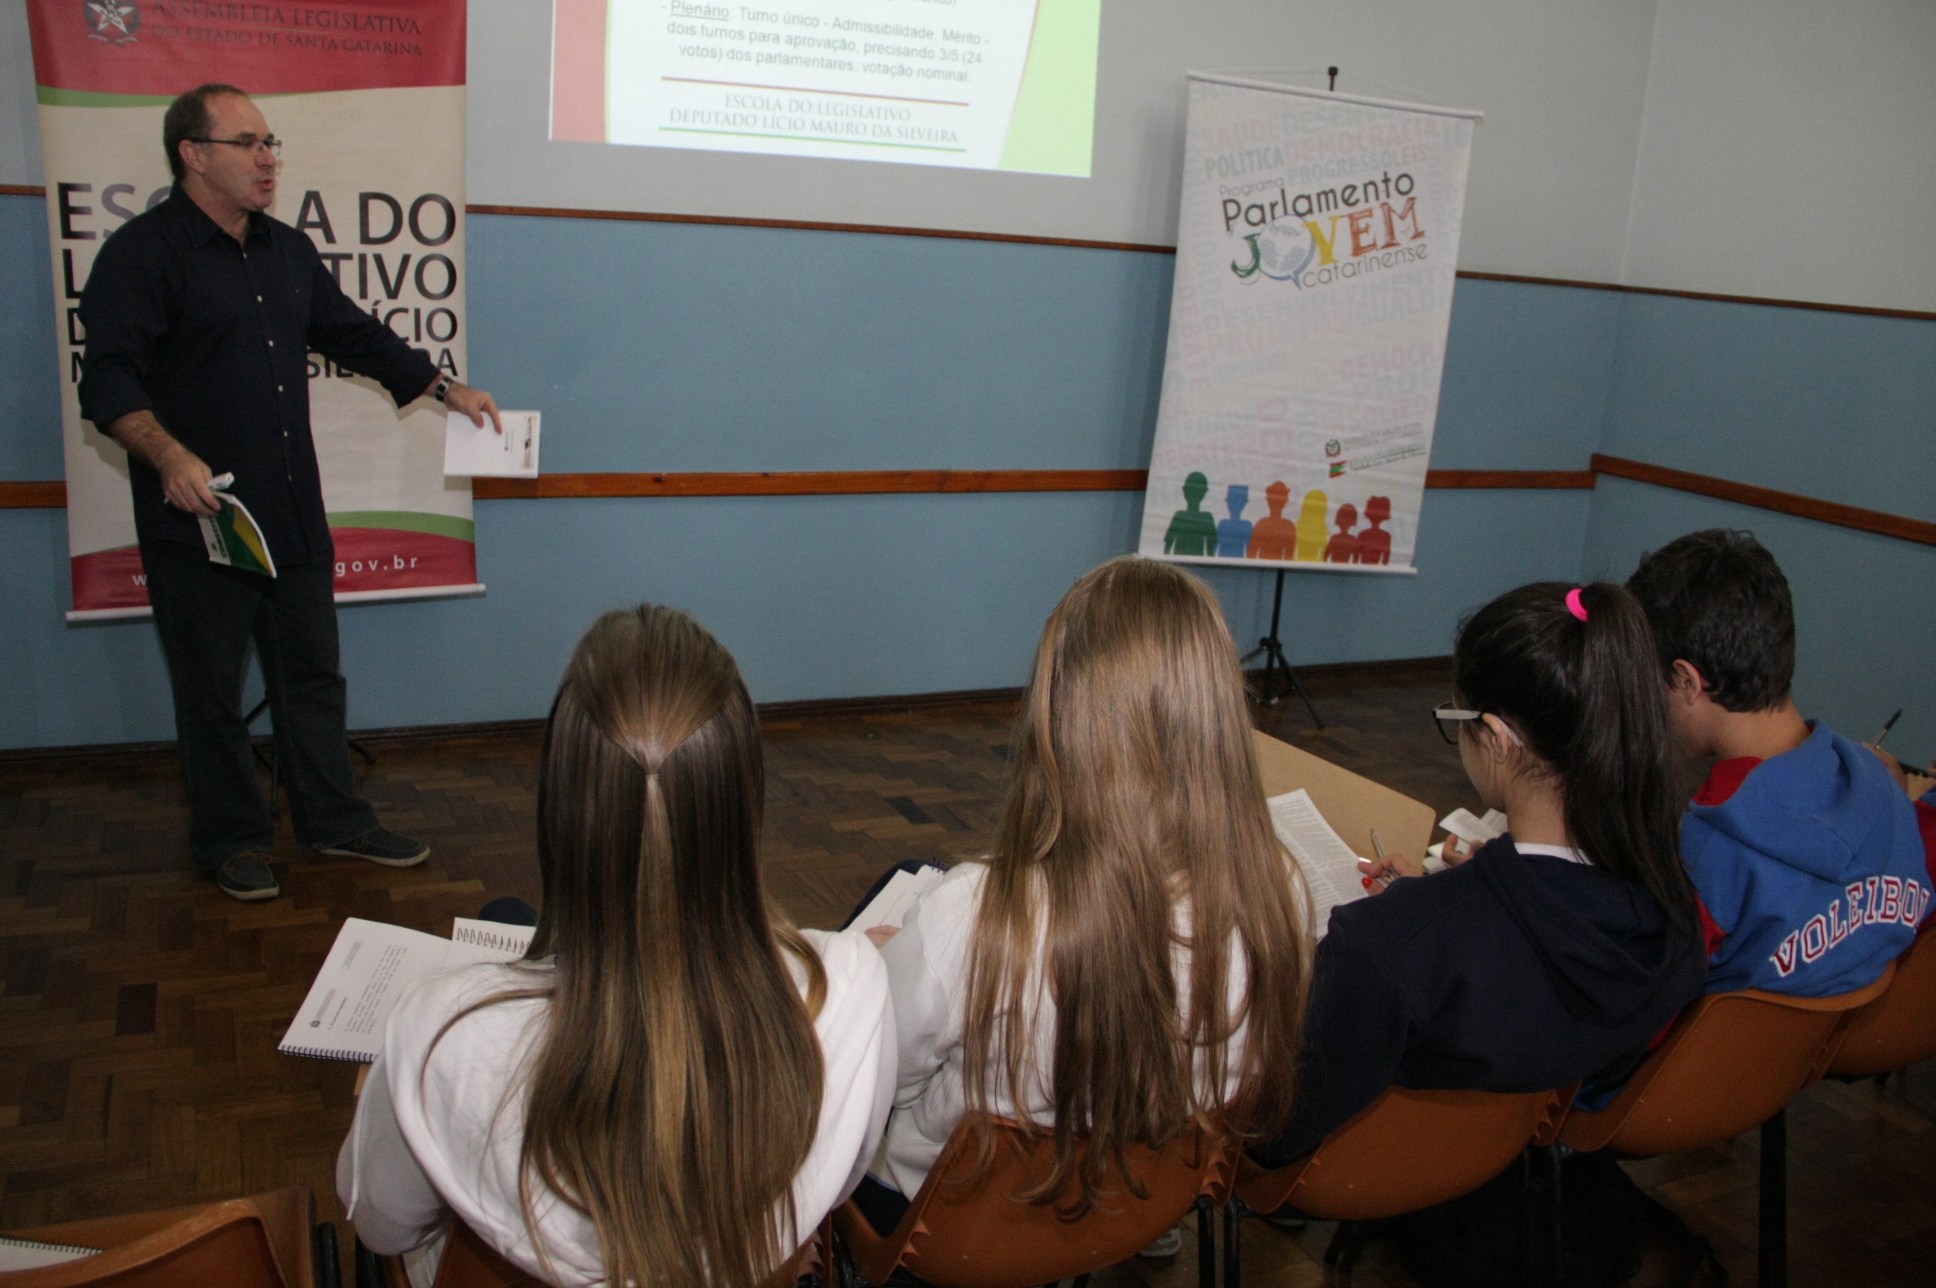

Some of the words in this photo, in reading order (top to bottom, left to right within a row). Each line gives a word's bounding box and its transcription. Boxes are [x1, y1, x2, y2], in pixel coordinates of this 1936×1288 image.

[152, 0, 286, 24] ASSEMBLEIA
[294, 10, 421, 35] LEGISLATIVA
[739, 6, 779, 23] Turno
[783, 12, 820, 28] único
[942, 28, 981, 45] Mérito
[152, 24, 179, 39] DO
[186, 27, 252, 44] ESTADO
[259, 32, 280, 46] DE
[286, 33, 337, 50] SANTA
[343, 38, 422, 56] CATARINA
[666, 21, 697, 36] dois
[700, 24, 745, 41] turnos
[748, 30, 780, 44] para
[785, 35, 859, 53] aprovação,
[863, 42, 935, 60] precisando
[938, 48, 959, 61] 3/5
[962, 50, 982, 66] (24
[679, 44, 723, 62] votos)
[726, 47, 752, 61] dos
[756, 51, 857, 73] parlamentares,
[862, 61, 913, 78] votação
[725, 93, 782, 111] ESCOLA
[788, 98, 812, 115] DO
[817, 101, 911, 121] LEGISLATIVO
[670, 108, 757, 128] DEPUTADO
[810, 119, 867, 136] MAURO
[872, 123, 893, 138] DA
[897, 125, 958, 143] SILVEIRA
[1287, 149, 1393, 186] PROGRESSO
[1219, 177, 1284, 198] Programa
[1222, 171, 1414, 232] Parlamento
[358, 191, 457, 247] DO
[1302, 243, 1428, 288] catarinense
